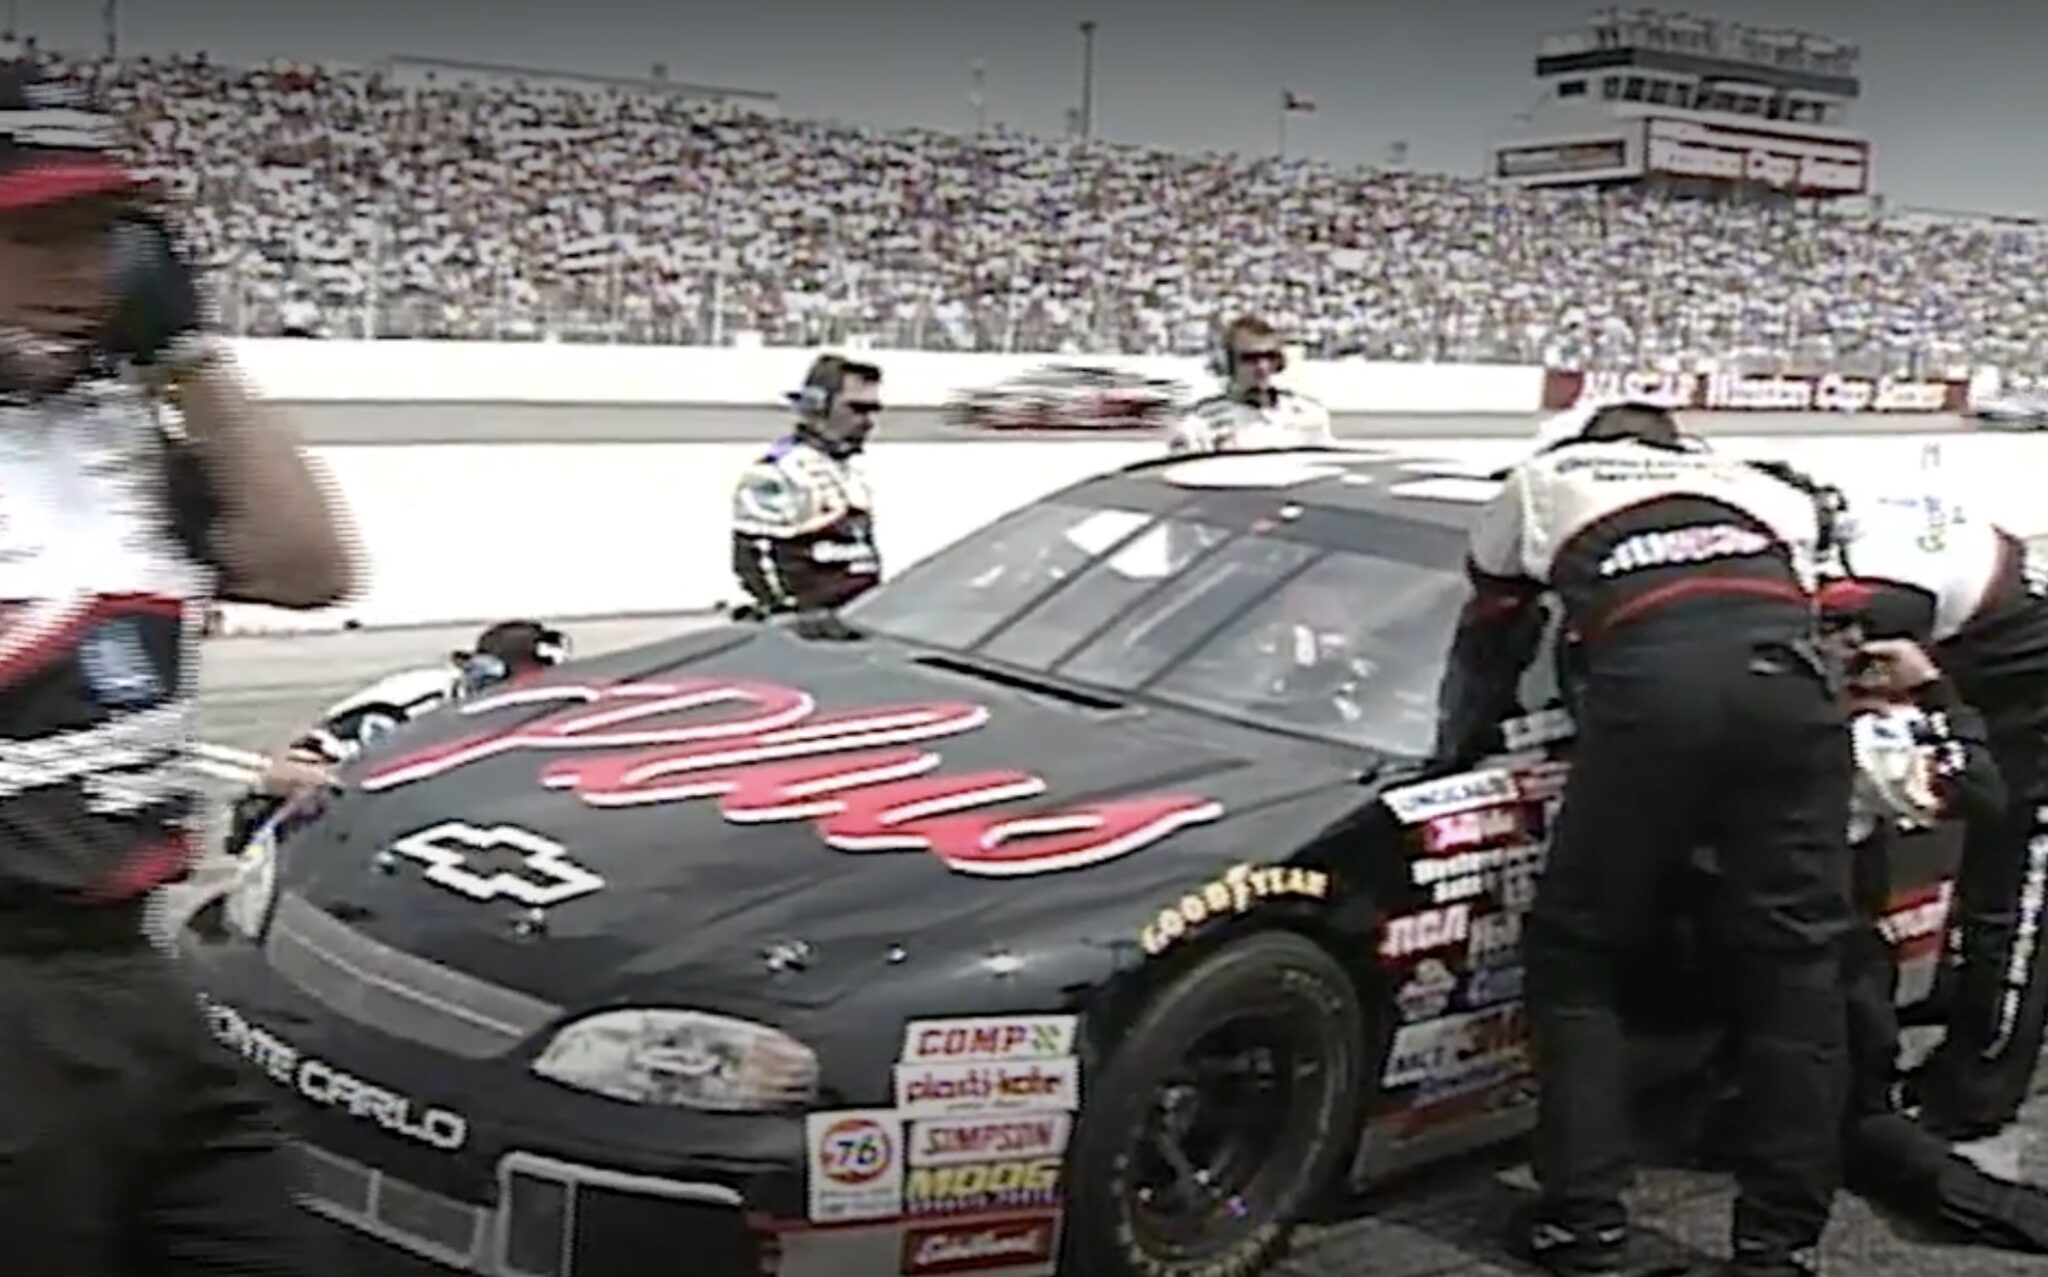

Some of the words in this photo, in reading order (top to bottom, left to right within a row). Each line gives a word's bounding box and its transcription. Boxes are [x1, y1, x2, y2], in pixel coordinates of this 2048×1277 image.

[362, 677, 1224, 877] Plus
[1141, 863, 1329, 955] GOODYEAR
[916, 1025, 1028, 1057] COMP
[197, 992, 297, 1083] ONTE
[298, 1060, 466, 1150] CARLO
[836, 1133, 879, 1167] 76
[923, 1124, 1056, 1154] SIMPSON
[904, 1158, 1066, 1200] MOOG
